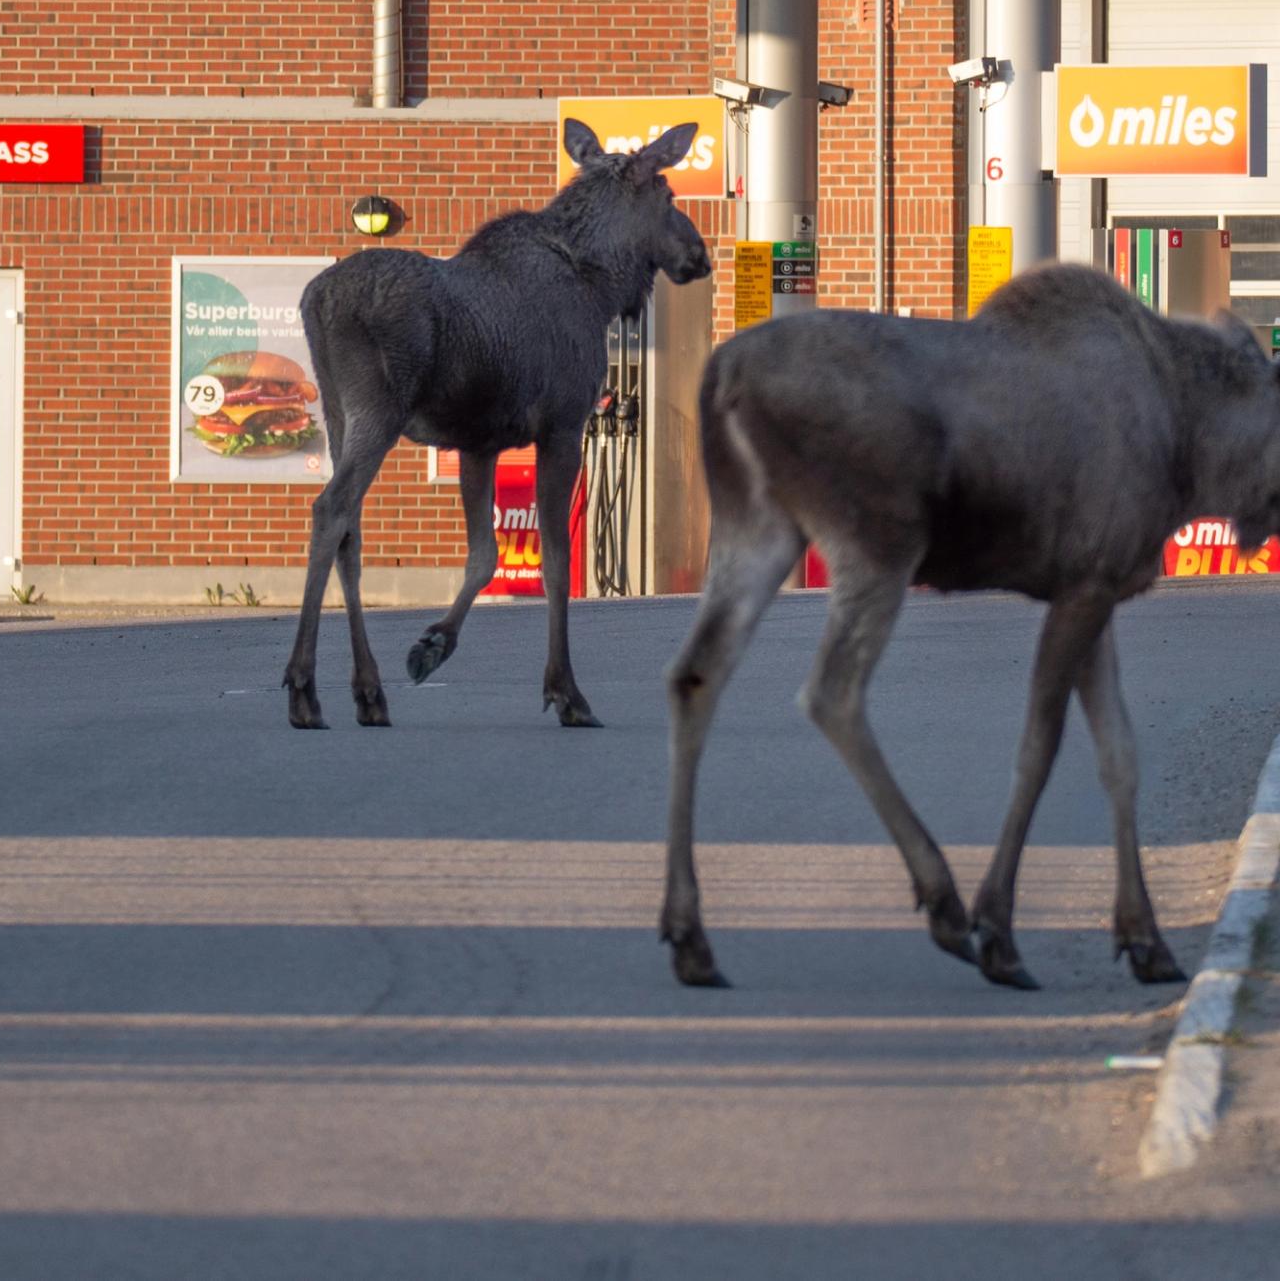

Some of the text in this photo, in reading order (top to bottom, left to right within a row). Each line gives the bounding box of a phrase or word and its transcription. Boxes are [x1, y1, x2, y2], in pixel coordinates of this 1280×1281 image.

[1106, 94, 1238, 146] miles
[986, 157, 1003, 181] 6
[735, 175, 744, 199] 4
[1172, 235, 1179, 245] 6
[185, 302, 302, 324] Superburg
